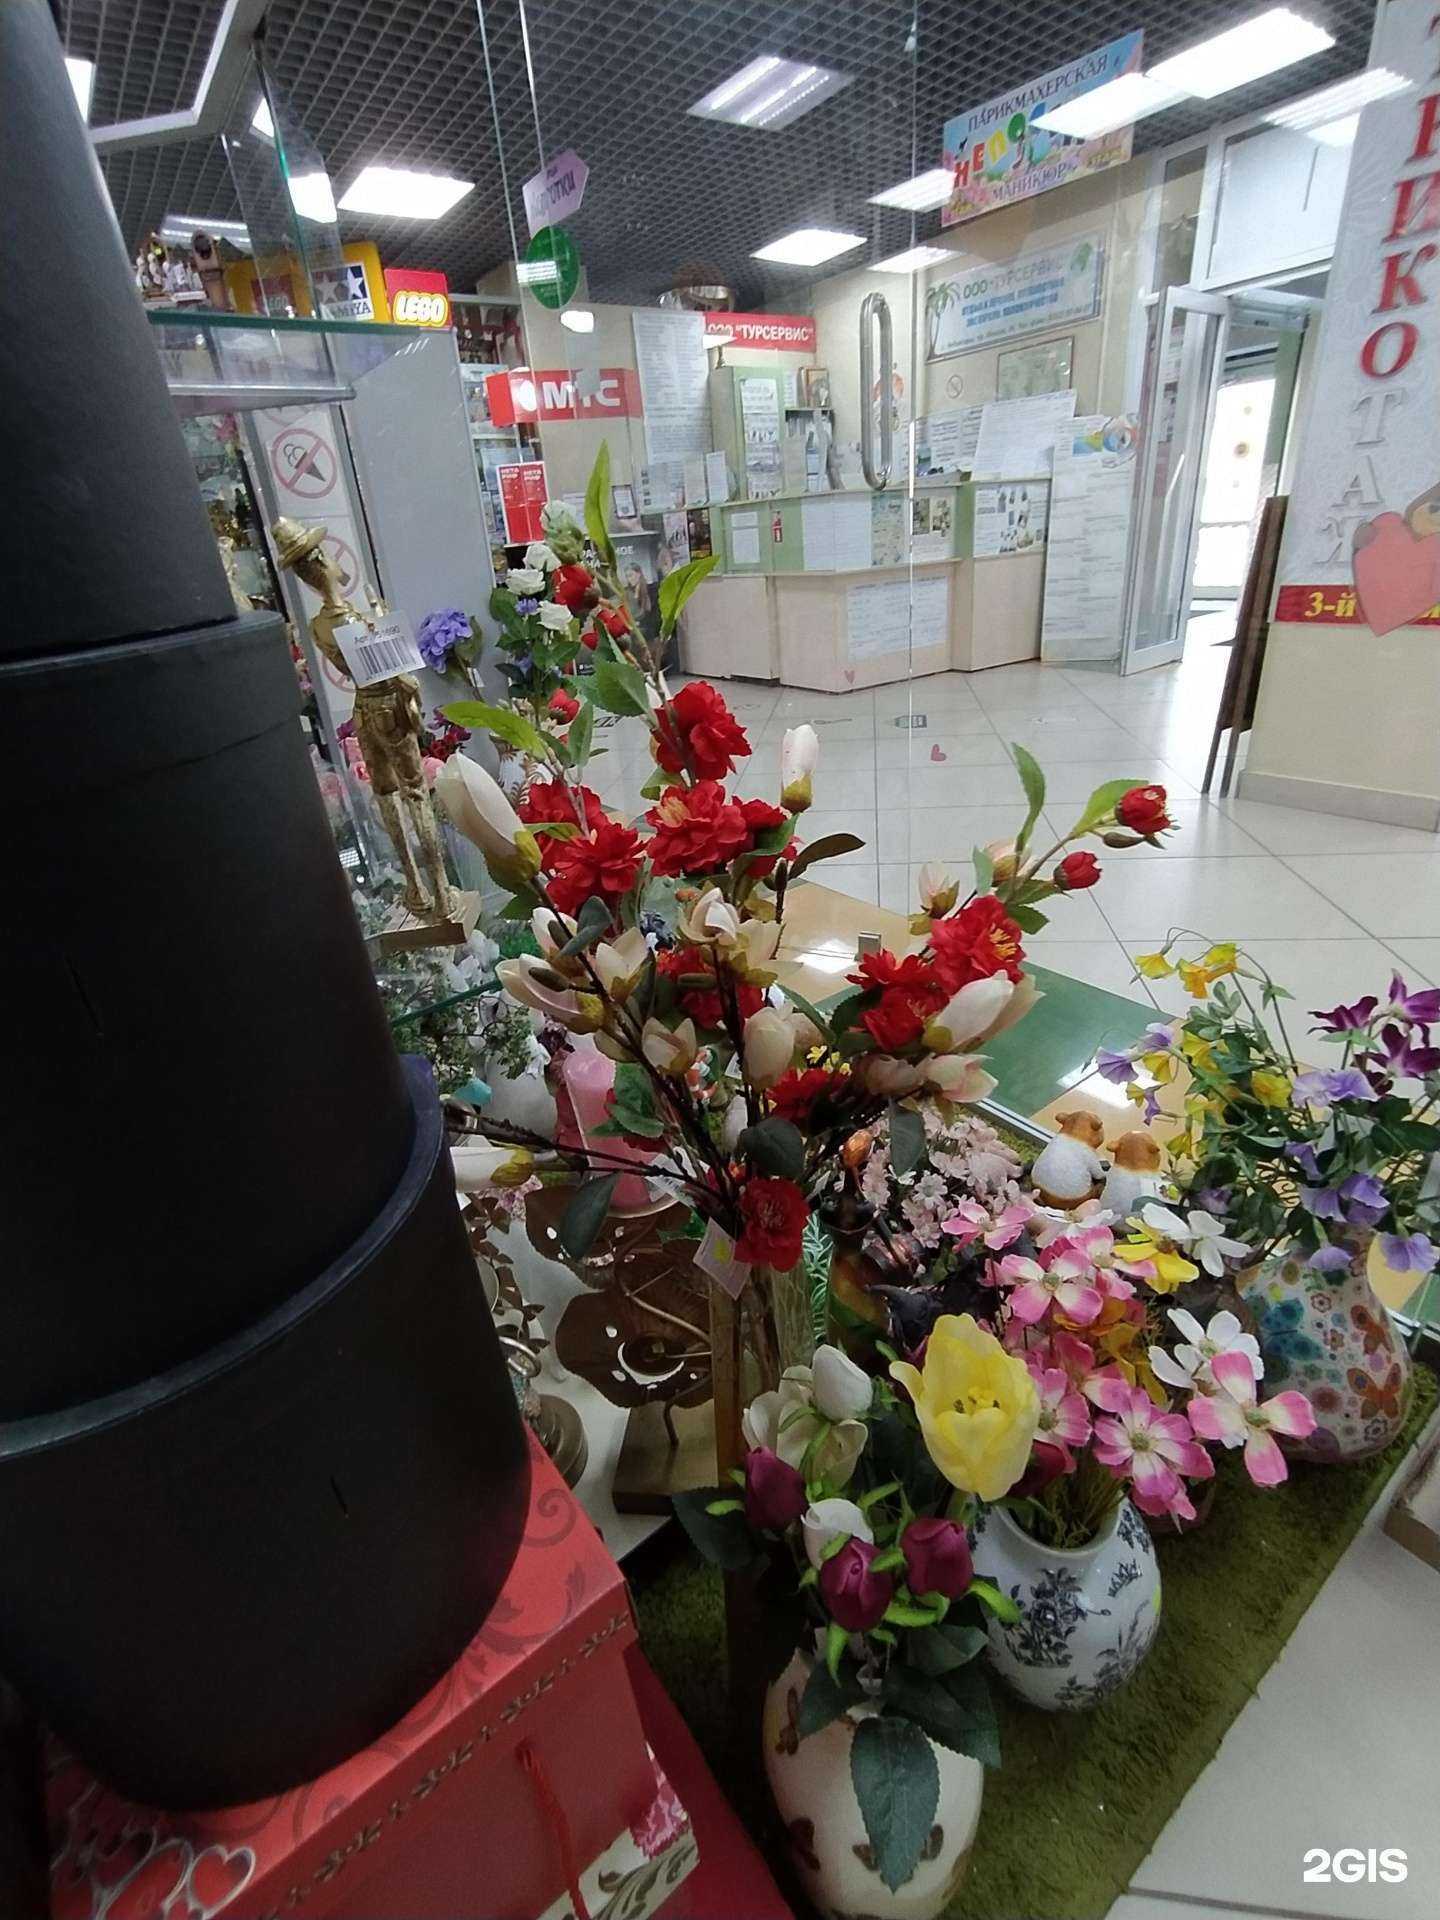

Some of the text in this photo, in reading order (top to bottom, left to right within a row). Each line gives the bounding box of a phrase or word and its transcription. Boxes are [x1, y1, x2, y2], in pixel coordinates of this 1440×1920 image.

[968, 54, 1108, 131] ПАРИКМАХЕРСКАЯ
[992, 163, 1067, 200] МАНИКЮР
[395, 292, 445, 324] LEGO
[735, 324, 814, 341] "ТУРСЕРВИС"
[542, 379, 621, 409] МС
[1304, 590, 1357, 618] 3-й
